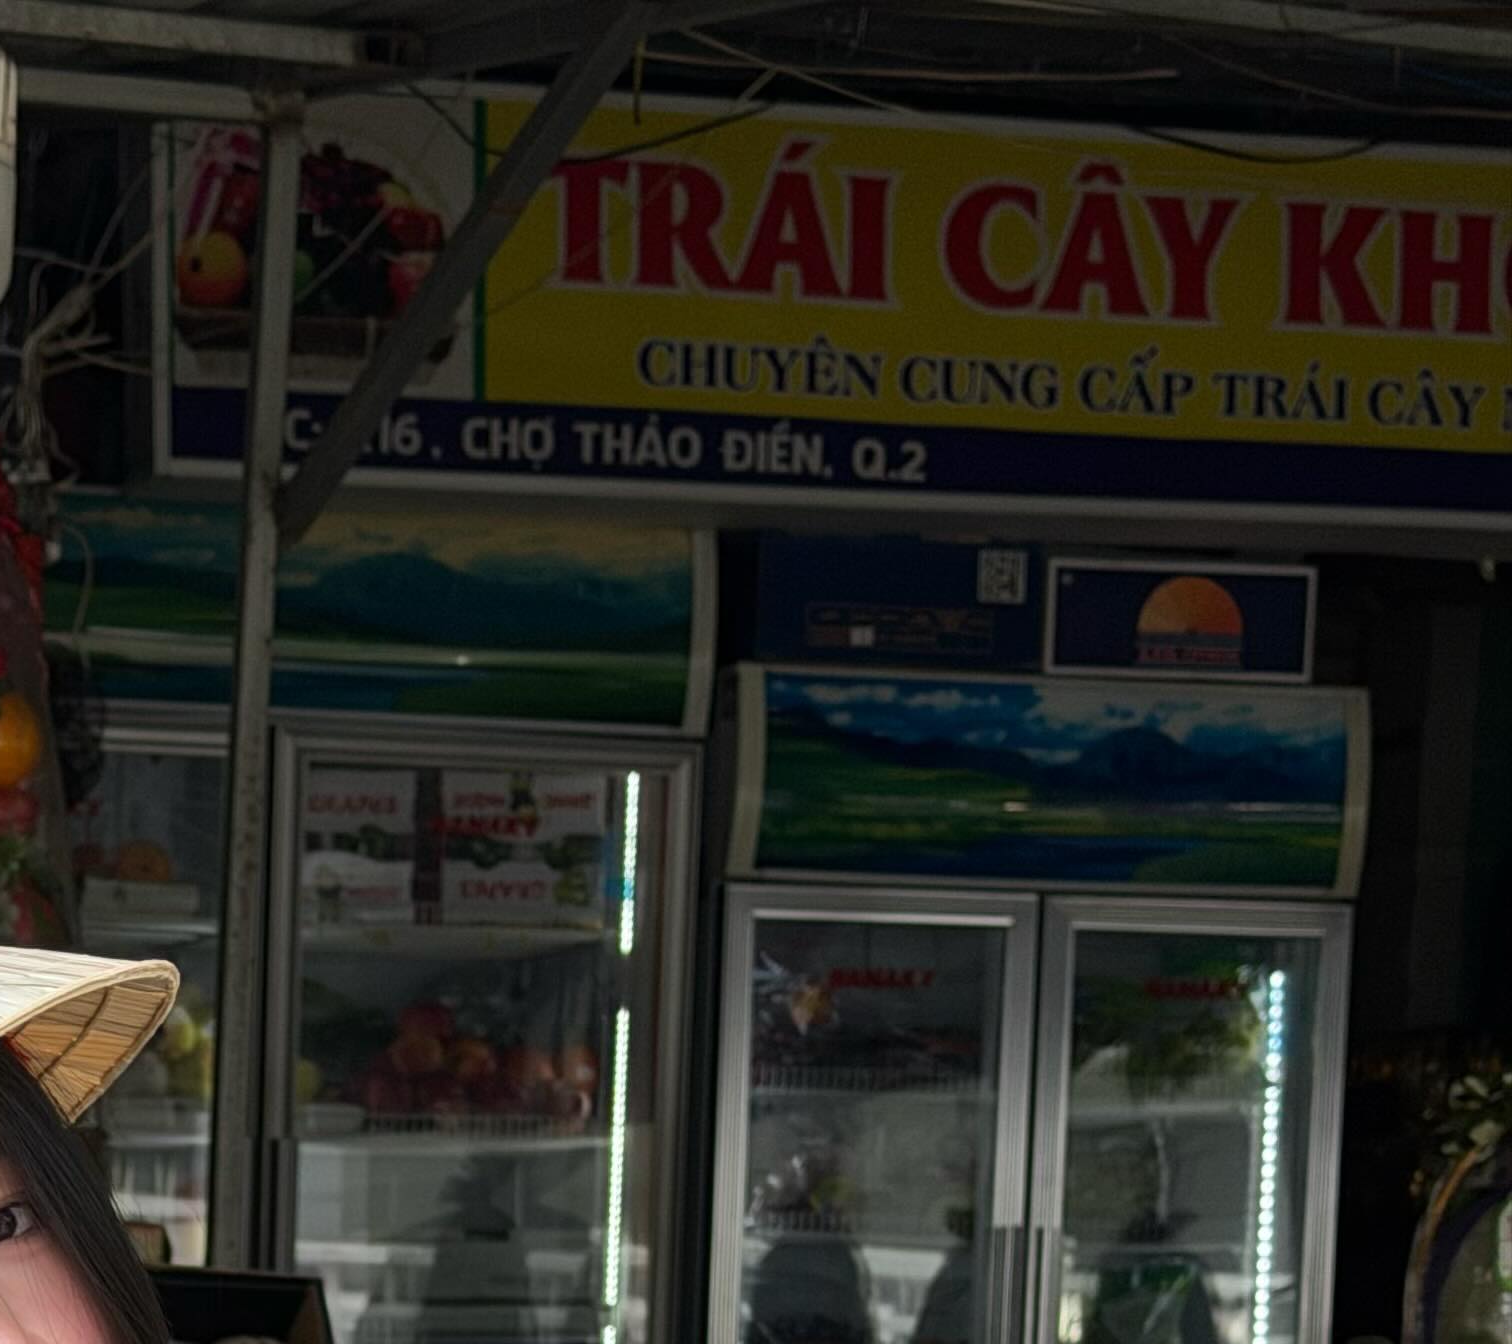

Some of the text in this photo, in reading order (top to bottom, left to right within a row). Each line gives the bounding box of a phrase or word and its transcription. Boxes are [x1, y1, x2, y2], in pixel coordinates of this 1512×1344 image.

[550, 141, 1512, 334] TRÁI CÂY KH
[639, 334, 882, 396] CHUYÊN
[901, 356, 1059, 409] CUNG
[1080, 343, 1193, 414] CẤP
[1213, 360, 1346, 420] TRÁI
[1369, 366, 1485, 428] CÂY
[461, 414, 556, 471] CHỢ
[851, 436, 928, 484] Q.2
